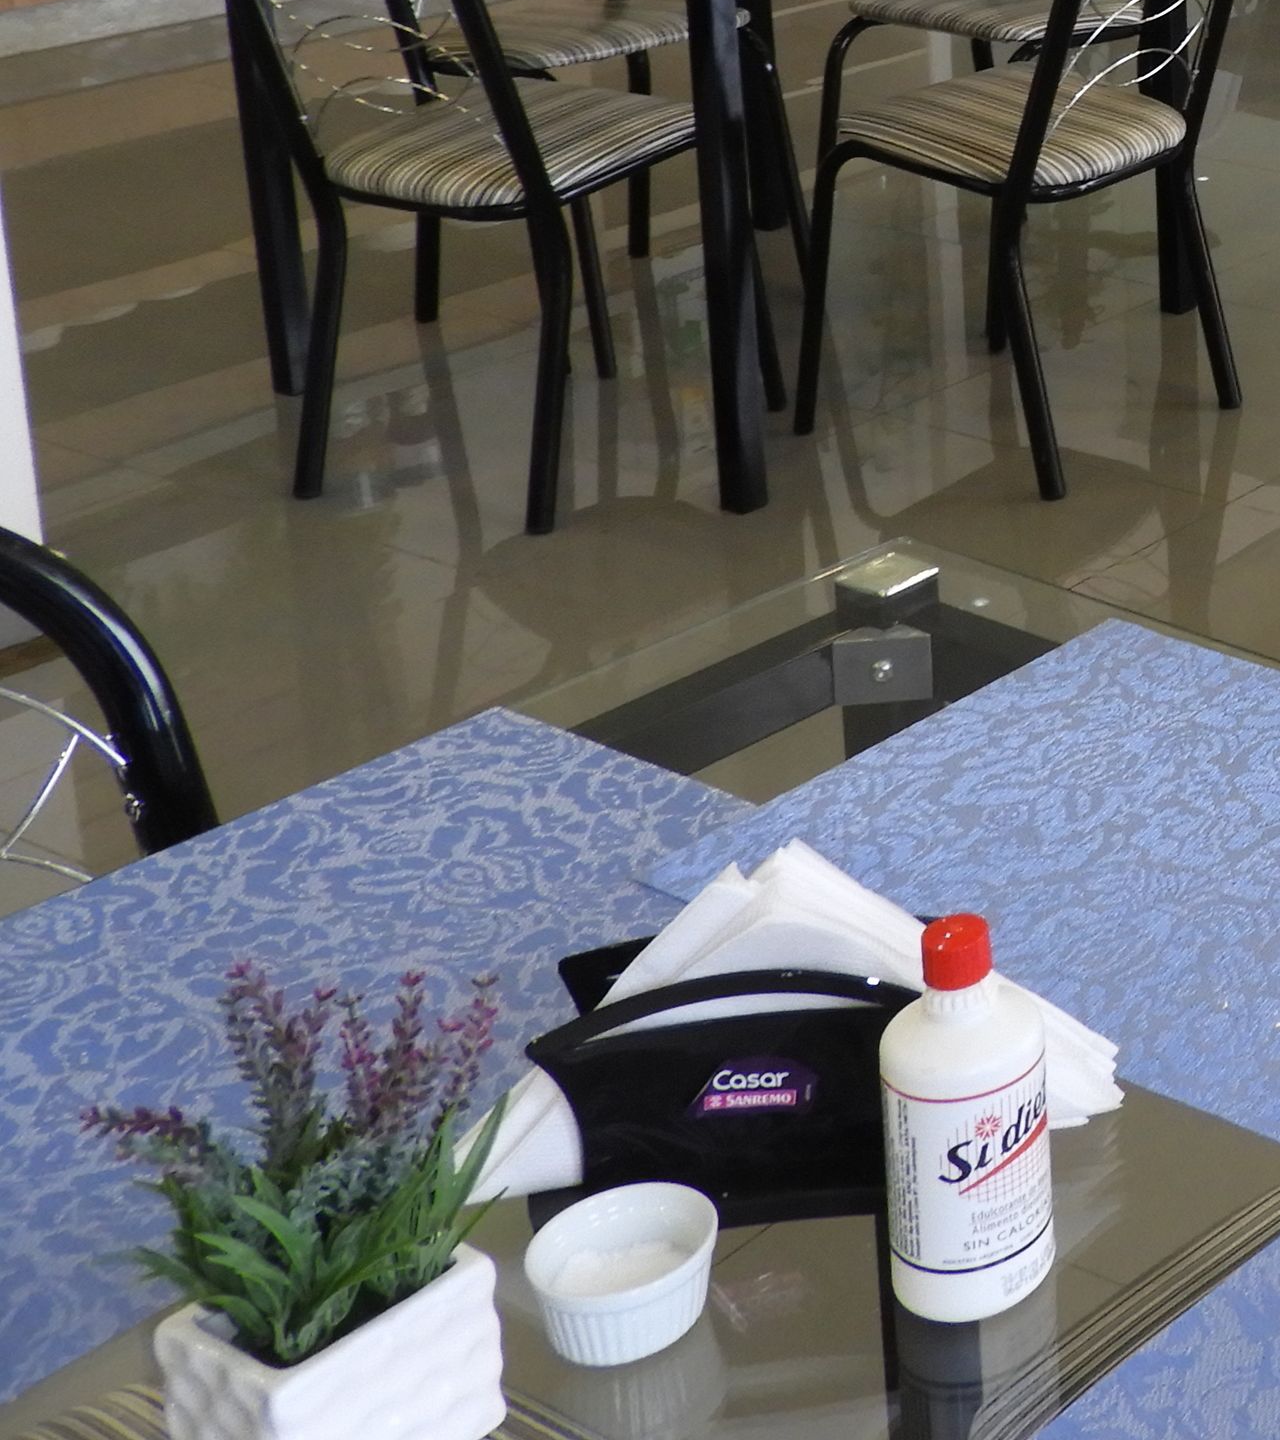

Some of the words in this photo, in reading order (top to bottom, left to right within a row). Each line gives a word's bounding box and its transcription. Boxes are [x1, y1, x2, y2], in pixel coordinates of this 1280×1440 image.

[712, 1069, 790, 1091] Casar
[726, 1092, 792, 1107] SANREMO
[963, 1237, 990, 1252] SIN
